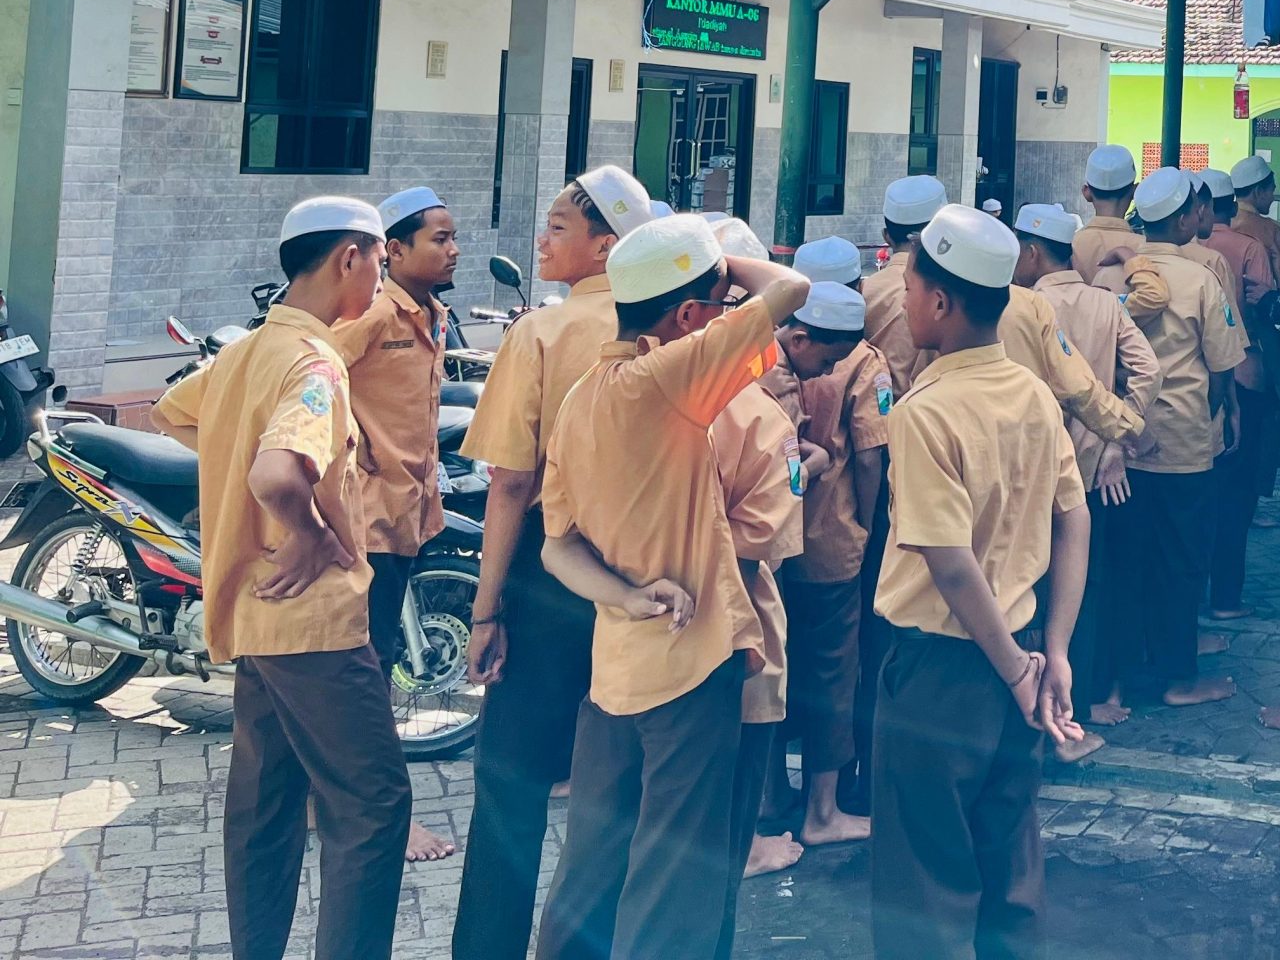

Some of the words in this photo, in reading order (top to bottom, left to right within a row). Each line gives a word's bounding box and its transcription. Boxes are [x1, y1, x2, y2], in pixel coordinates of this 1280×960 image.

[709, 1, 736, 18] MMU
[737, 7, 760, 22] A-06
[56, 468, 112, 507] Supra
